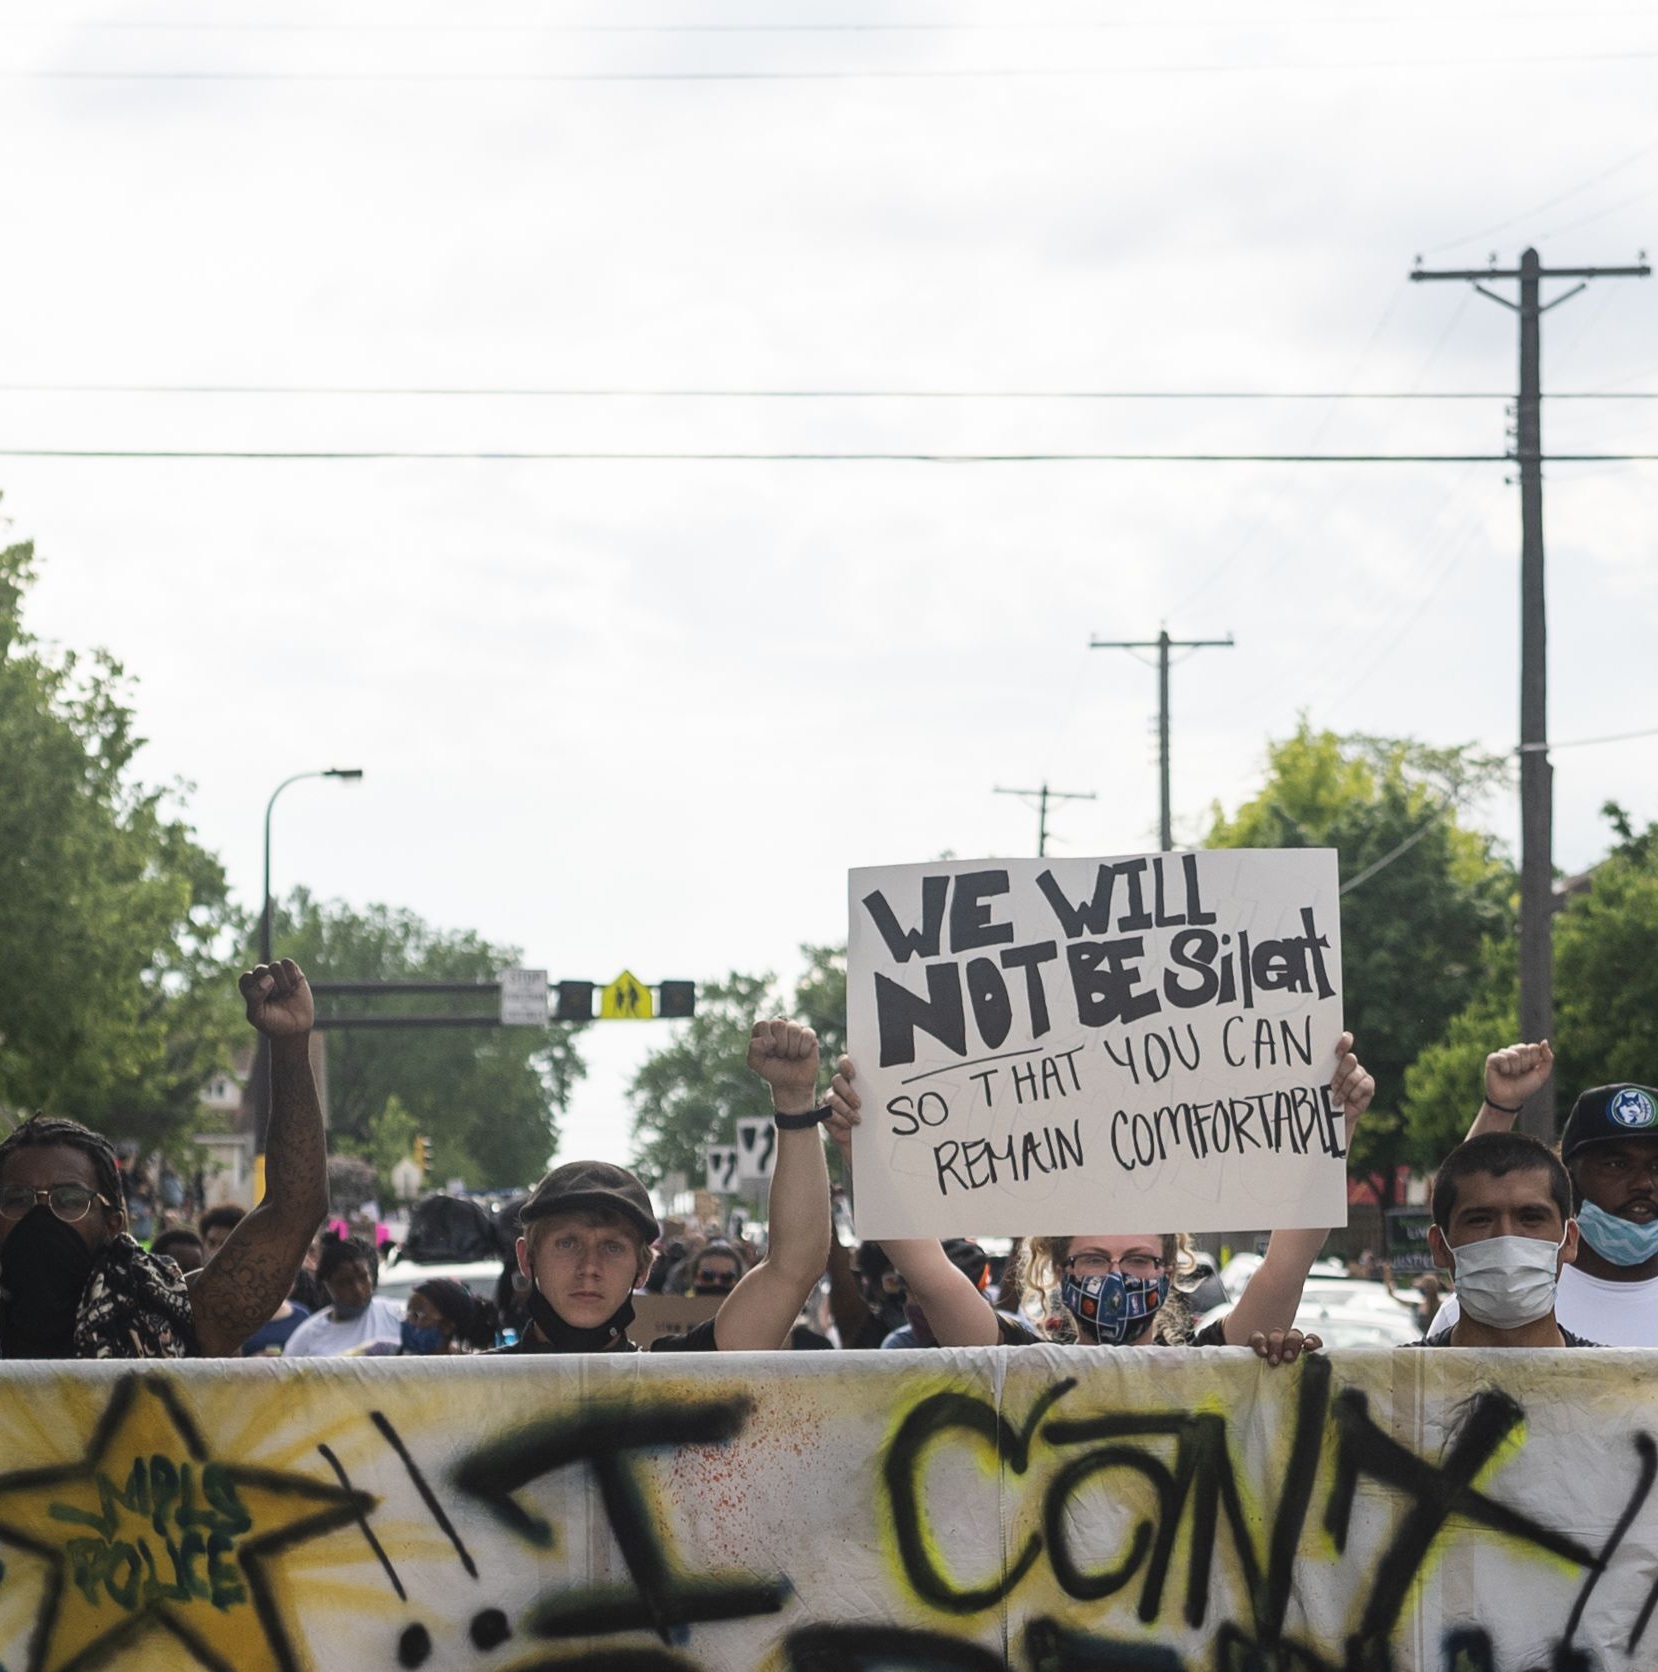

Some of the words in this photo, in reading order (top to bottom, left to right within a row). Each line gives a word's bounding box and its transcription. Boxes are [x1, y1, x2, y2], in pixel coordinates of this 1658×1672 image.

[862, 869, 1014, 963] WE
[1036, 854, 1217, 938] WILL
[874, 940, 1058, 1068] NOT
[1066, 936, 1162, 1028] BE
[1163, 907, 1337, 1009] Silent
[886, 1091, 949, 1136] SO
[969, 1045, 1085, 1107] THAT
[1103, 1023, 1202, 1084] YOU
[1222, 1015, 1312, 1069] CAN
[933, 1119, 1085, 1196] REMAIN
[1110, 1083, 1346, 1172] COMFORTABLE
[47, 1453, 251, 1543] MPLS
[456, 1394, 791, 1642] I
